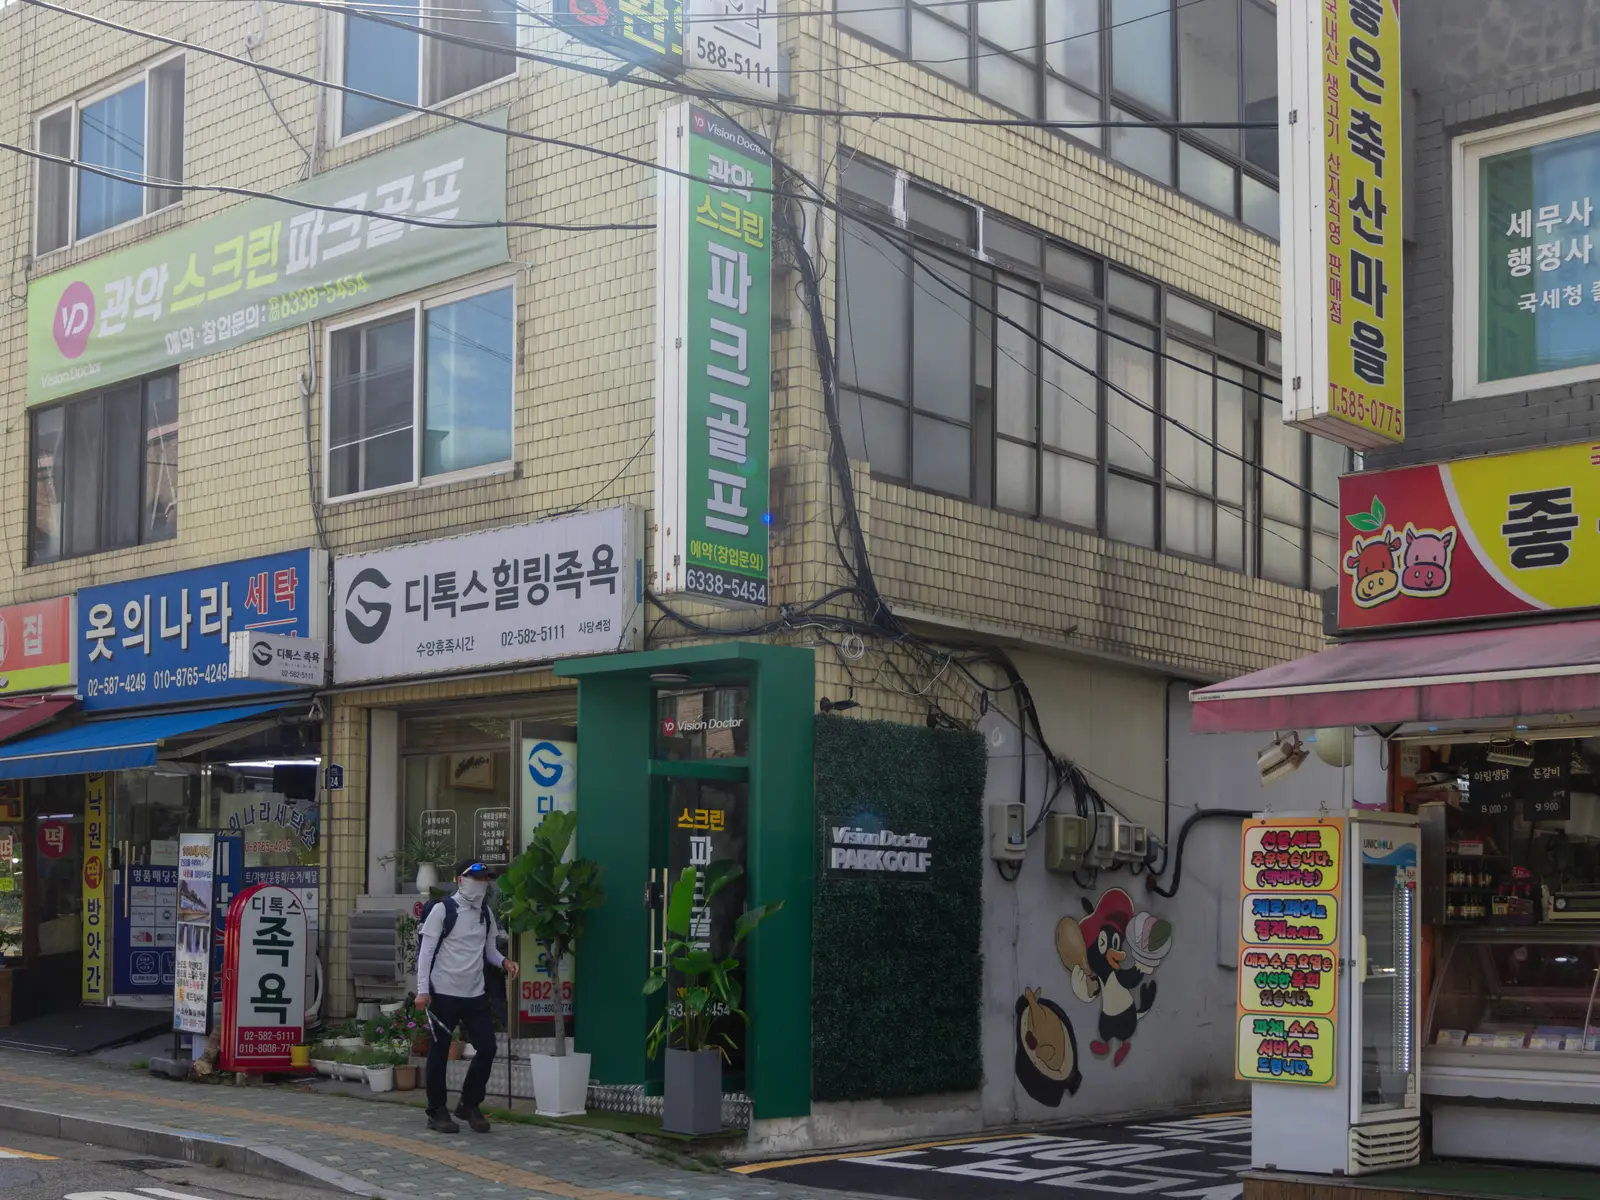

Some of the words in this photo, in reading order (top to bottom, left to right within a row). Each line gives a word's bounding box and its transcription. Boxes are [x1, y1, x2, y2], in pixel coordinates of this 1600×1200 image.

[697, 36, 770, 88] 588-5111
[1325, 73, 1340, 144] 생고기
[707, 120, 736, 143] Vision
[708, 154, 753, 203] 관악
[696, 194, 764, 248] 스크린
[1505, 197, 1594, 238] 세무사
[100, 264, 170, 337] 관악
[171, 220, 282, 312] 스크린
[286, 157, 465, 275] 파크골프
[1507, 234, 1593, 277] 행정사
[1328, 253, 1343, 325] 판매점
[1517, 283, 1582, 313] 국세청
[705, 240, 753, 535] 파크골프
[690, 539, 764, 571] 예약(창업문의)
[244, 567, 299, 615] 세탁
[405, 543, 619, 621] 디톡스힐링족욕
[686, 567, 767, 603] 6338-5454
[86, 581, 232, 663] 옷의나라
[501, 624, 565, 647] 02-582-5111
[277, 648, 302, 661] 디톡스
[87, 671, 147, 697] 02-587-4249
[153, 662, 228, 691] 010-8765-4249
[677, 719, 707, 731] Vision
[708, 717, 743, 730] Doctor
[677, 808, 725, 831] 스크린
[44, 826, 63, 853] 떡
[832, 827, 880, 846] Vision
[880, 830, 932, 849] Doctor
[1261, 830, 1321, 851] 선물세트
[252, 896, 301, 916] 디톡스
[1252, 898, 1327, 919] 제로페이로
[250, 916, 295, 1025] 족욕
[244, 1031, 295, 1041] 02-582-5111
[1257, 1038, 1313, 1058] 서비스로
